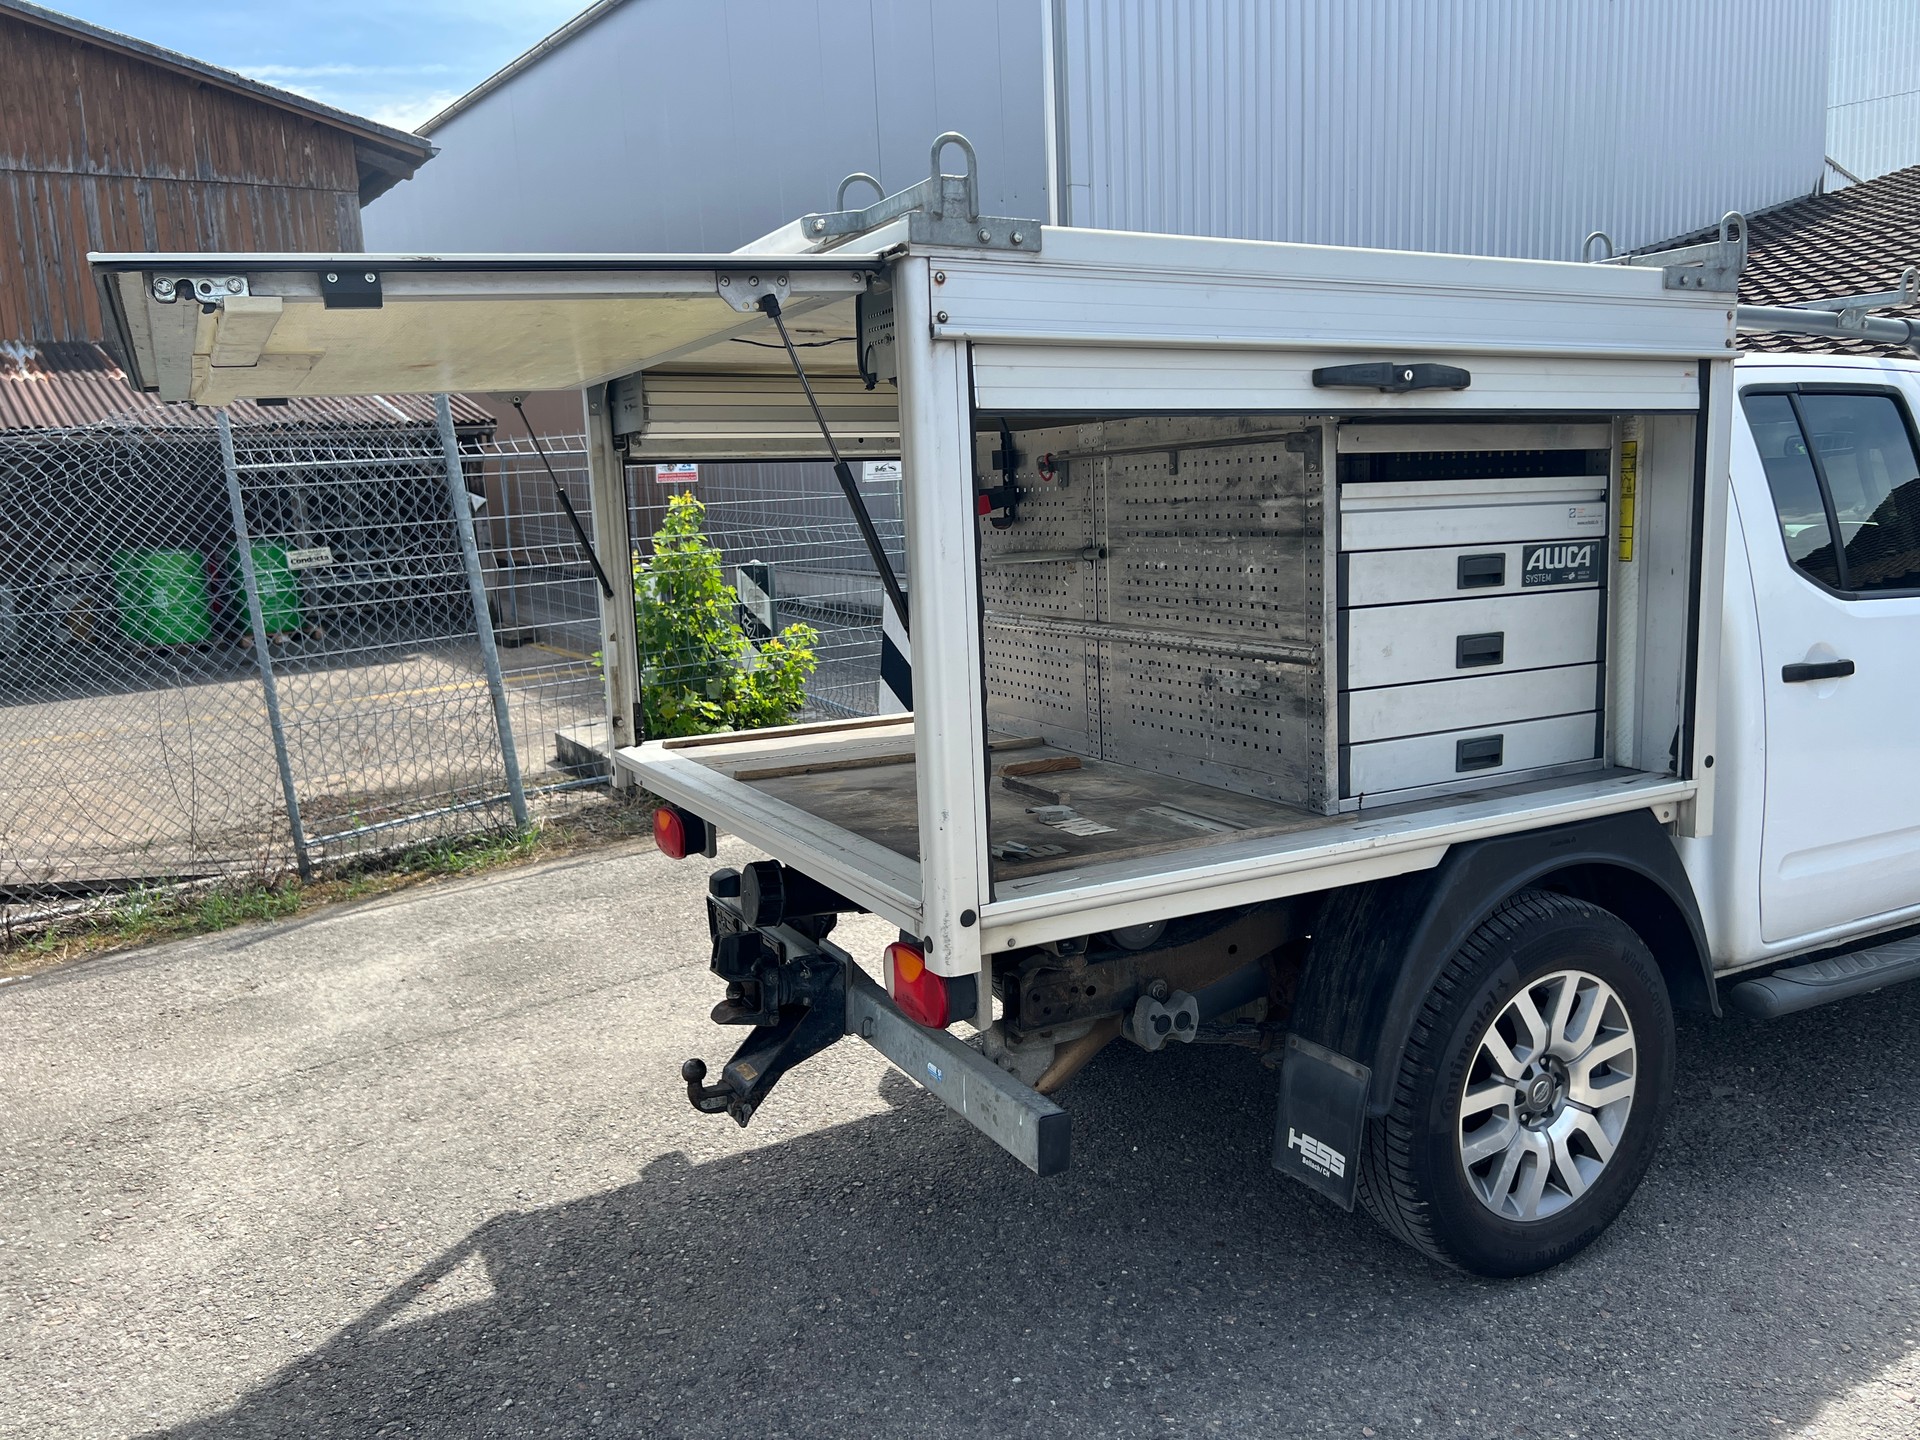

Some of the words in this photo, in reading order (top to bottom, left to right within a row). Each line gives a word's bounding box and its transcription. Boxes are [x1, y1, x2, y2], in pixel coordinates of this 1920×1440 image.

[1526, 545, 1591, 571] ALUCA
[1525, 573, 1552, 584] SYSTEM
[1439, 988, 1499, 1119] Continental
[1287, 1127, 1346, 1178] HESS
